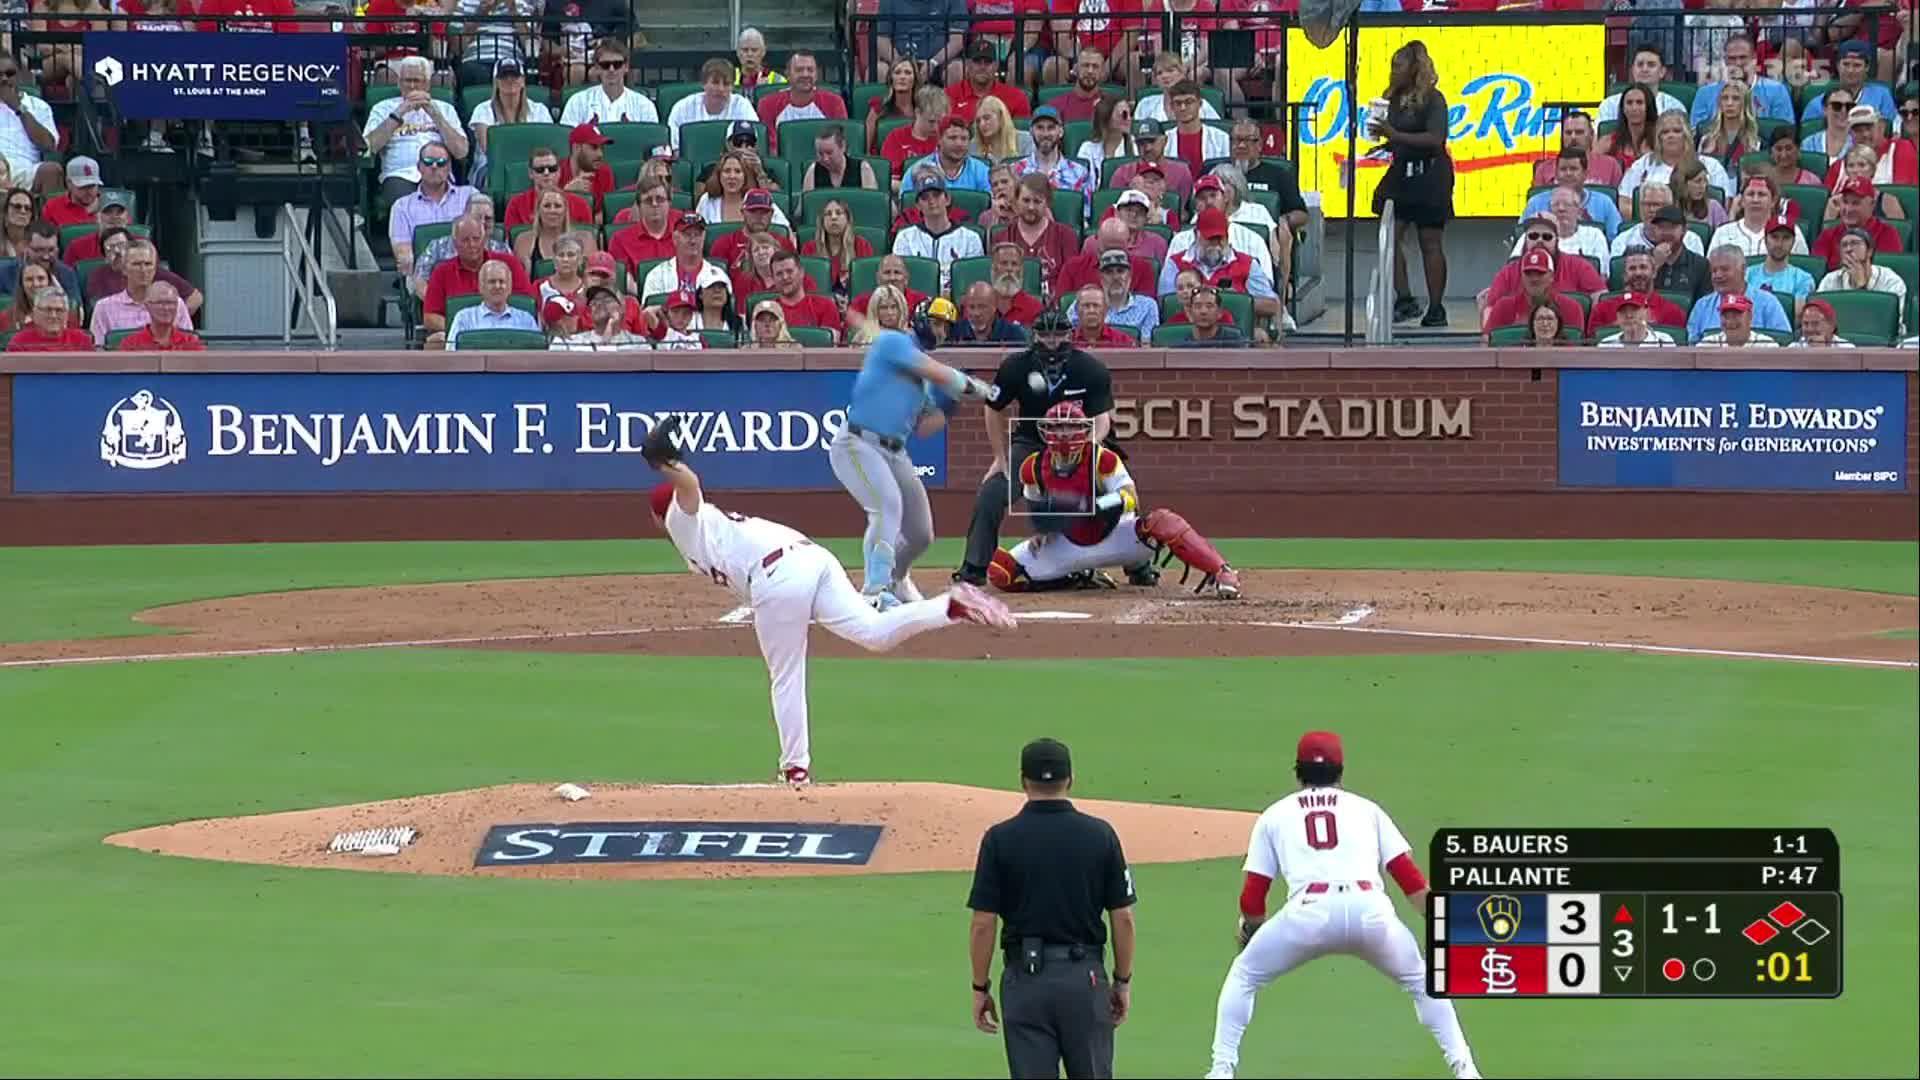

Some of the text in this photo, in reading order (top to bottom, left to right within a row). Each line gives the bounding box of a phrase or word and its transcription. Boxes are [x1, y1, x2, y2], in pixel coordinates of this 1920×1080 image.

[132, 63, 335, 82] HYATT REGENCY
[173, 87, 266, 96] ST. LOUIS AT THE ARCH
[1111, 396, 1473, 440] SCH STADIUM
[1580, 401, 1877, 432] BENJAMIN F. EDWARDS
[206, 402, 847, 466] BENJAMIN F. EDWARDS
[1587, 436, 1870, 455] INVESTMENTS for GENERATIONS
[1834, 471, 1898, 482] Member SIPC
[493, 829, 856, 861] STIFEL
[1304, 810, 1339, 851] 0
